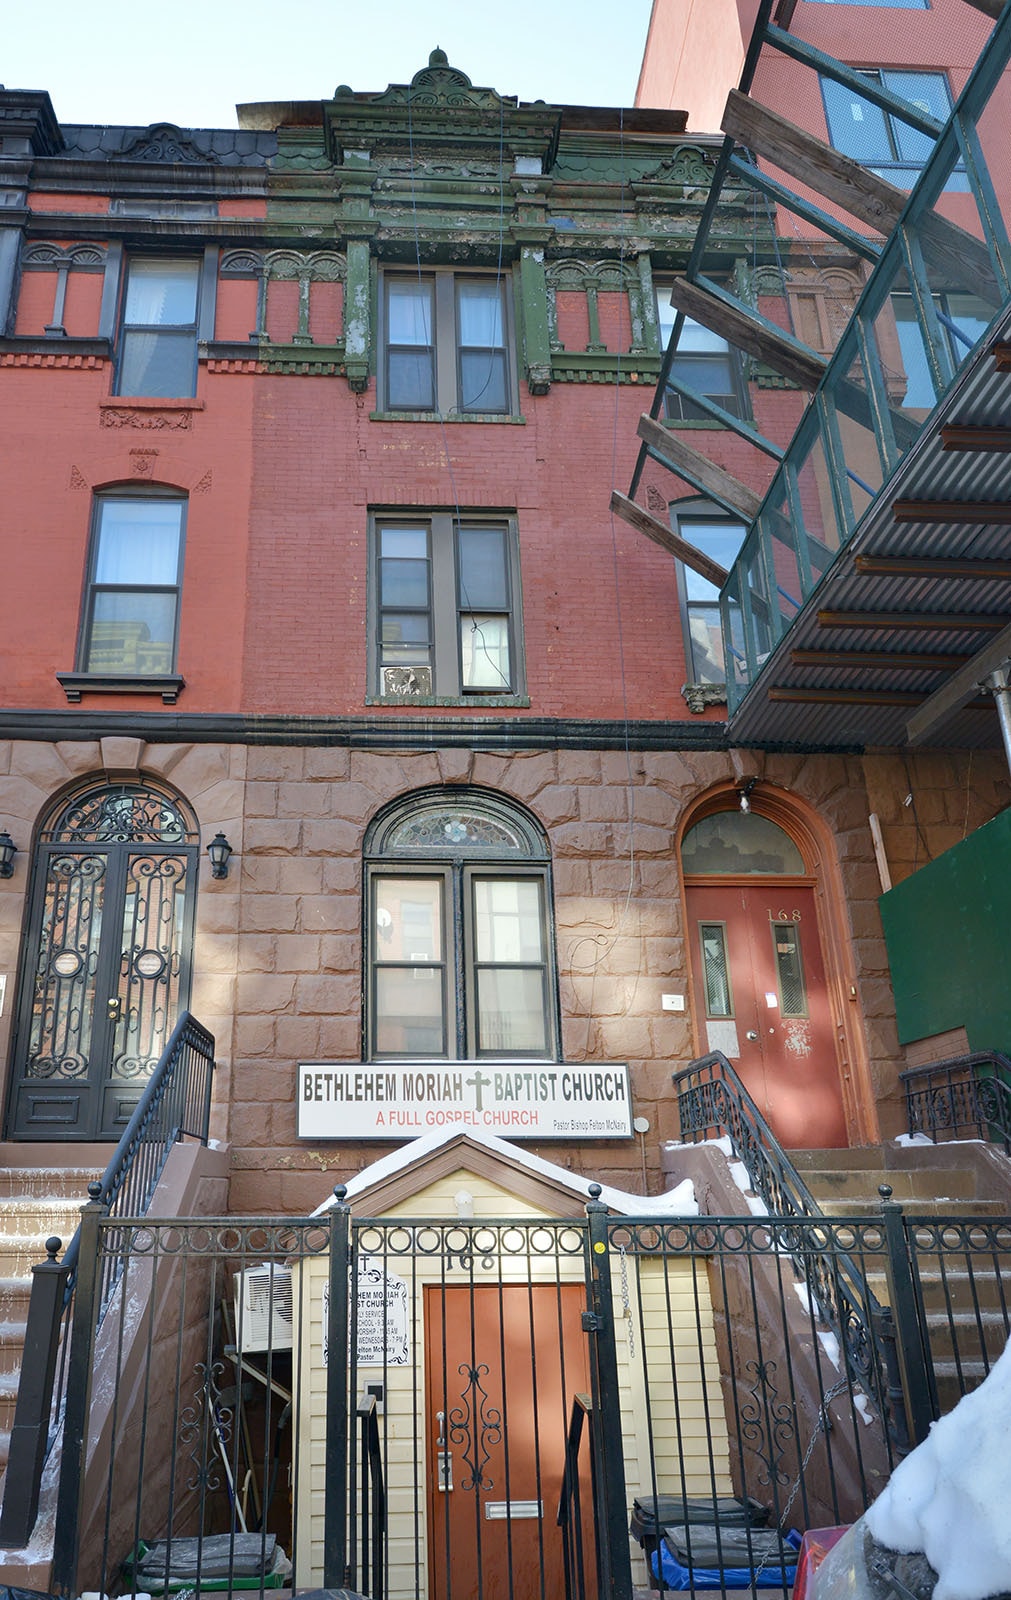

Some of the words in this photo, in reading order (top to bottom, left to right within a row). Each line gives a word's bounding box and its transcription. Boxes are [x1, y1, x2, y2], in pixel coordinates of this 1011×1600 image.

[766, 908, 802, 922] 168
[303, 1073, 397, 1102] BETHLEHEM
[402, 1073, 463, 1102] MORIAH
[494, 1072, 557, 1102] BAPTIST
[562, 1072, 625, 1101] CHURCH
[375, 1111, 385, 1126] A
[389, 1111, 422, 1126] FULL
[425, 1110, 480, 1126] GOSPEL
[483, 1110, 539, 1126] CHURCH
[553, 1119, 570, 1131] Pastor
[571, 1119, 588, 1133] Bishop
[589, 1119, 605, 1131] Felton
[606, 1119, 627, 1133] McNairy
[446, 1245, 495, 1271] 168
[373, 1291, 399, 1300] MOIAH
[357, 1319, 374, 1327] CHOOL
[373, 1346, 395, 1354] McNiry
